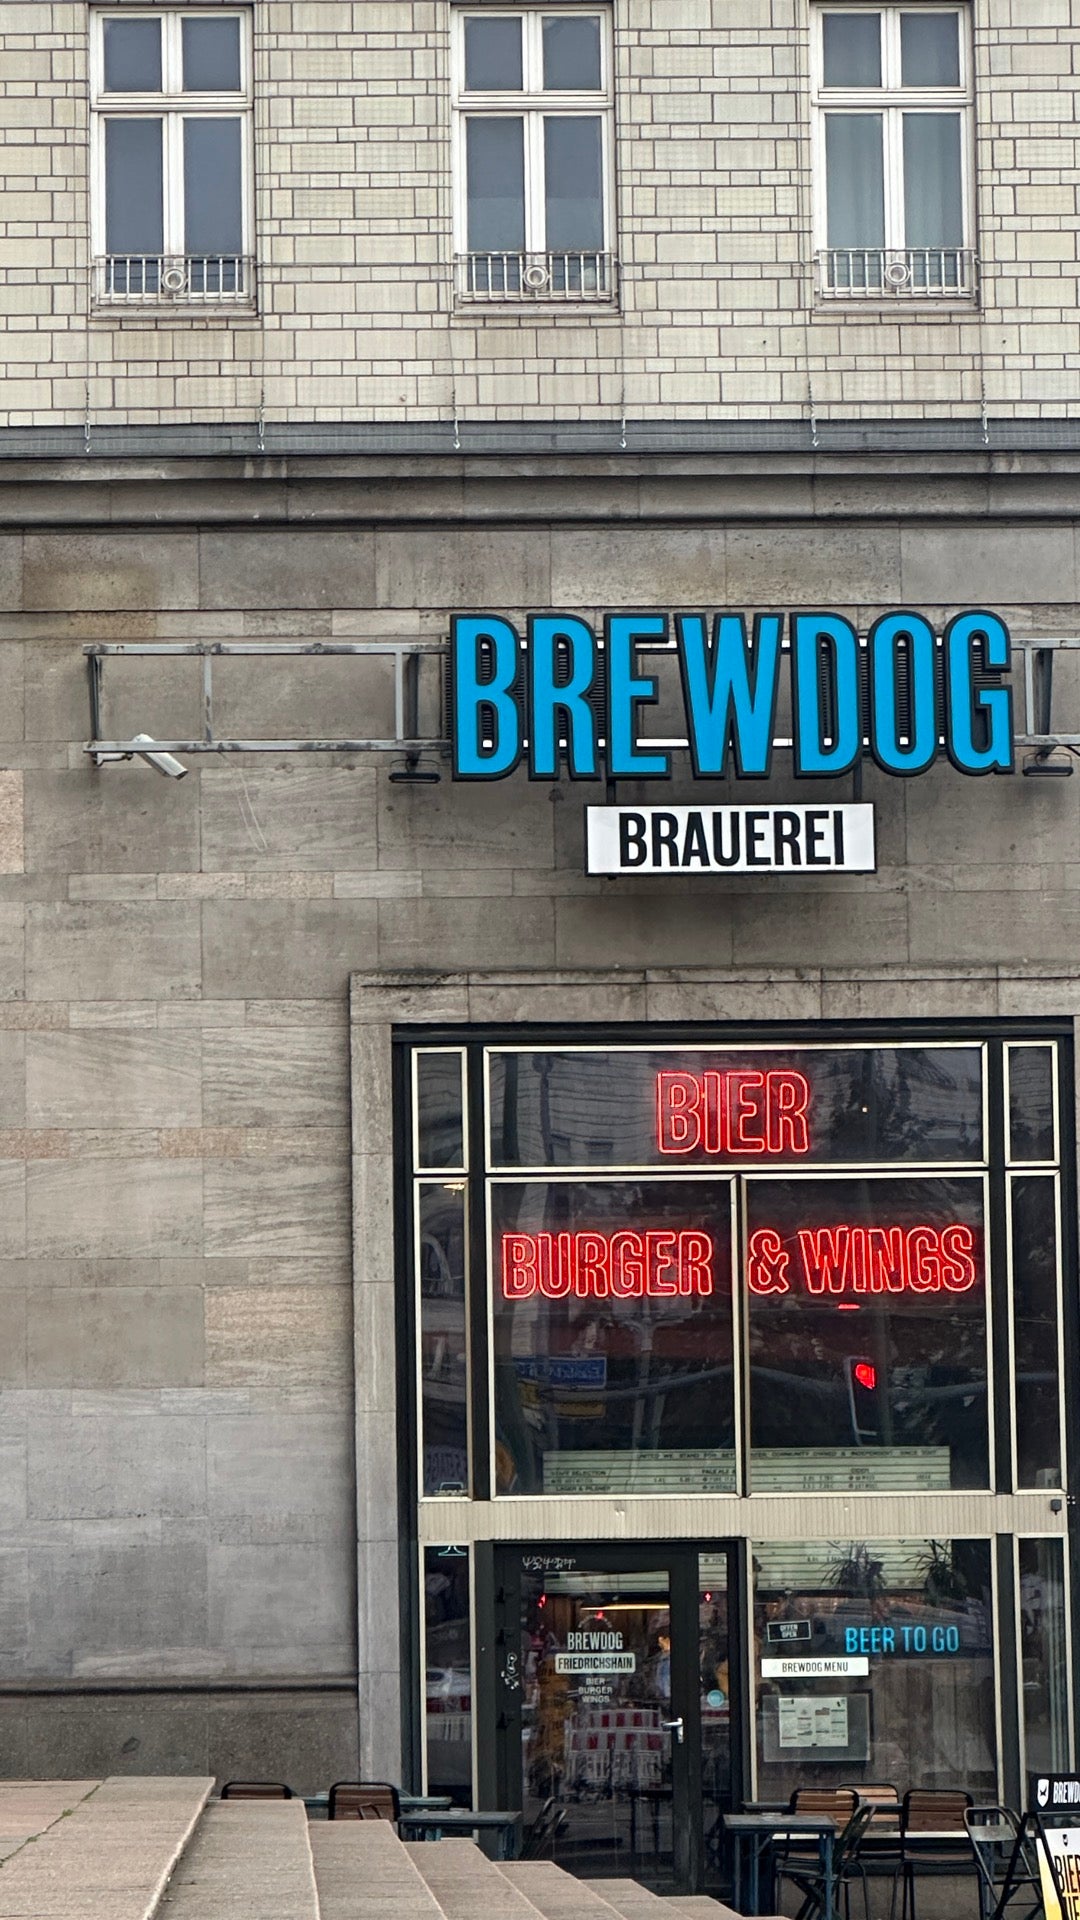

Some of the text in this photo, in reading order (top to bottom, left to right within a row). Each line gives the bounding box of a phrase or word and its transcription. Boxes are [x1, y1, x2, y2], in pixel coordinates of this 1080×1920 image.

[450, 609, 1015, 781] BREWDOG
[618, 809, 845, 868] BRAUEREI
[657, 1070, 810, 1155] BIER
[501, 1224, 977, 1299] BURGER & WINGS
[567, 1631, 623, 1651] BREWDOG
[845, 1625, 960, 1653] BEER TO GO
[558, 1657, 633, 1670] FRIEDRICHSHAIN
[781, 1661, 849, 1673] BREWDOG MENU
[578, 1686, 612, 1695] BURGER
[586, 1678, 606, 1686] BIER
[582, 1695, 610, 1703] WINGS
[1053, 1781, 1080, 1804] BREWD
